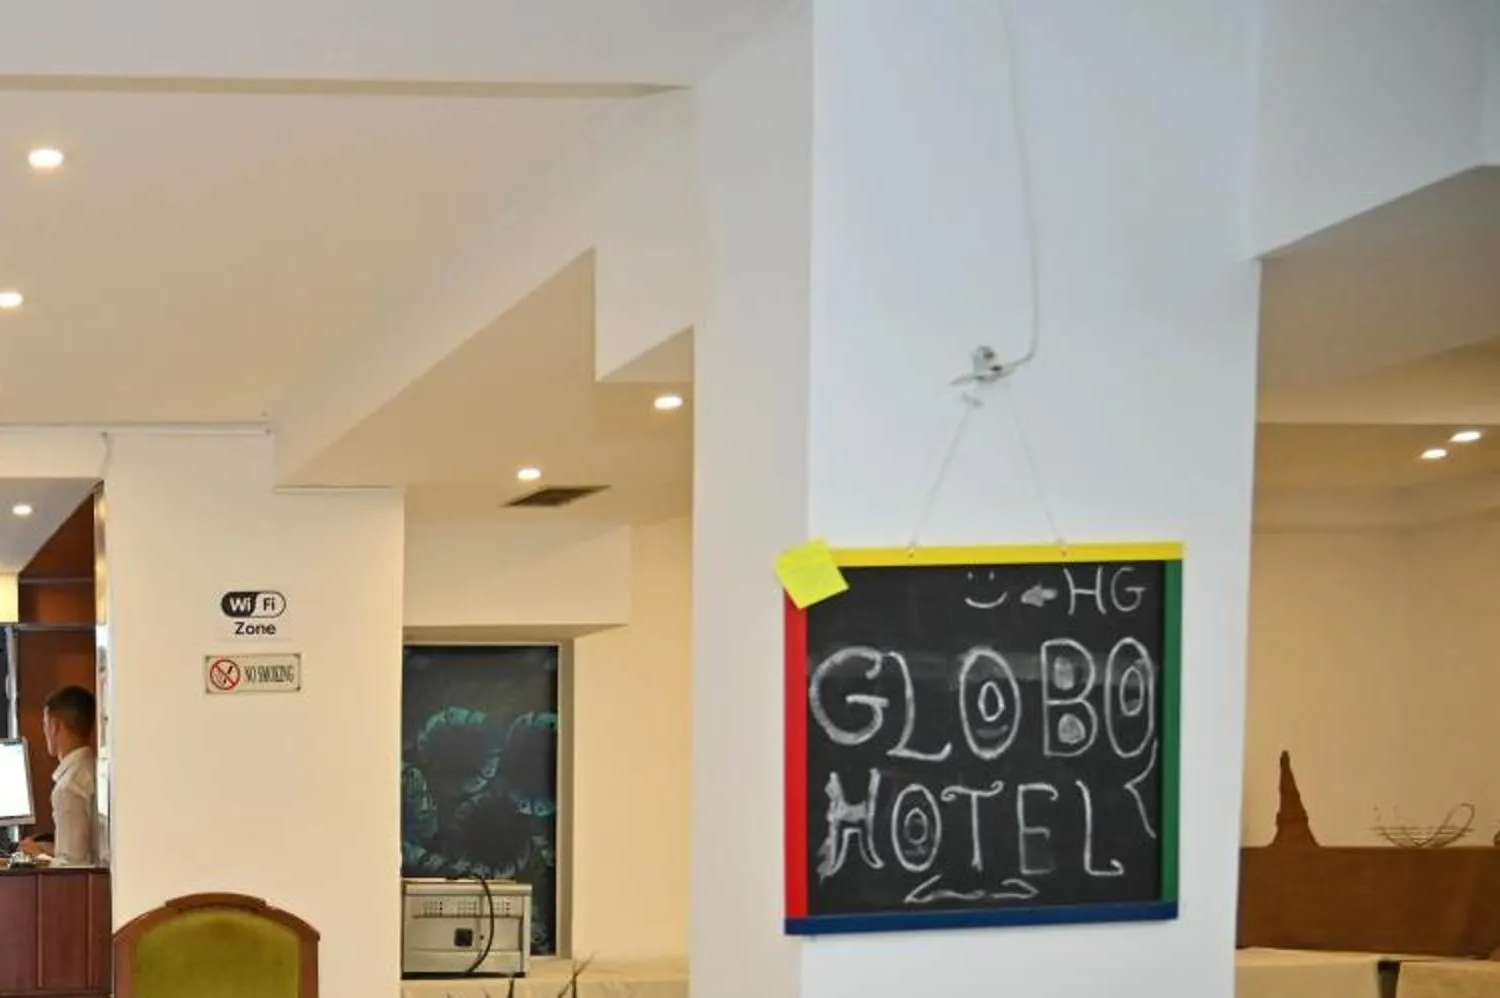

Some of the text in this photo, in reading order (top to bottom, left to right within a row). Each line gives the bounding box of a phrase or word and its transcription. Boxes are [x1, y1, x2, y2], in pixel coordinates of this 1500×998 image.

[1064, 567, 1148, 615] HG
[234, 621, 277, 635] Zone
[244, 665, 295, 683] NO SMOKING
[808, 637, 1156, 760] GLOBO
[817, 768, 1125, 880] HOTEL
